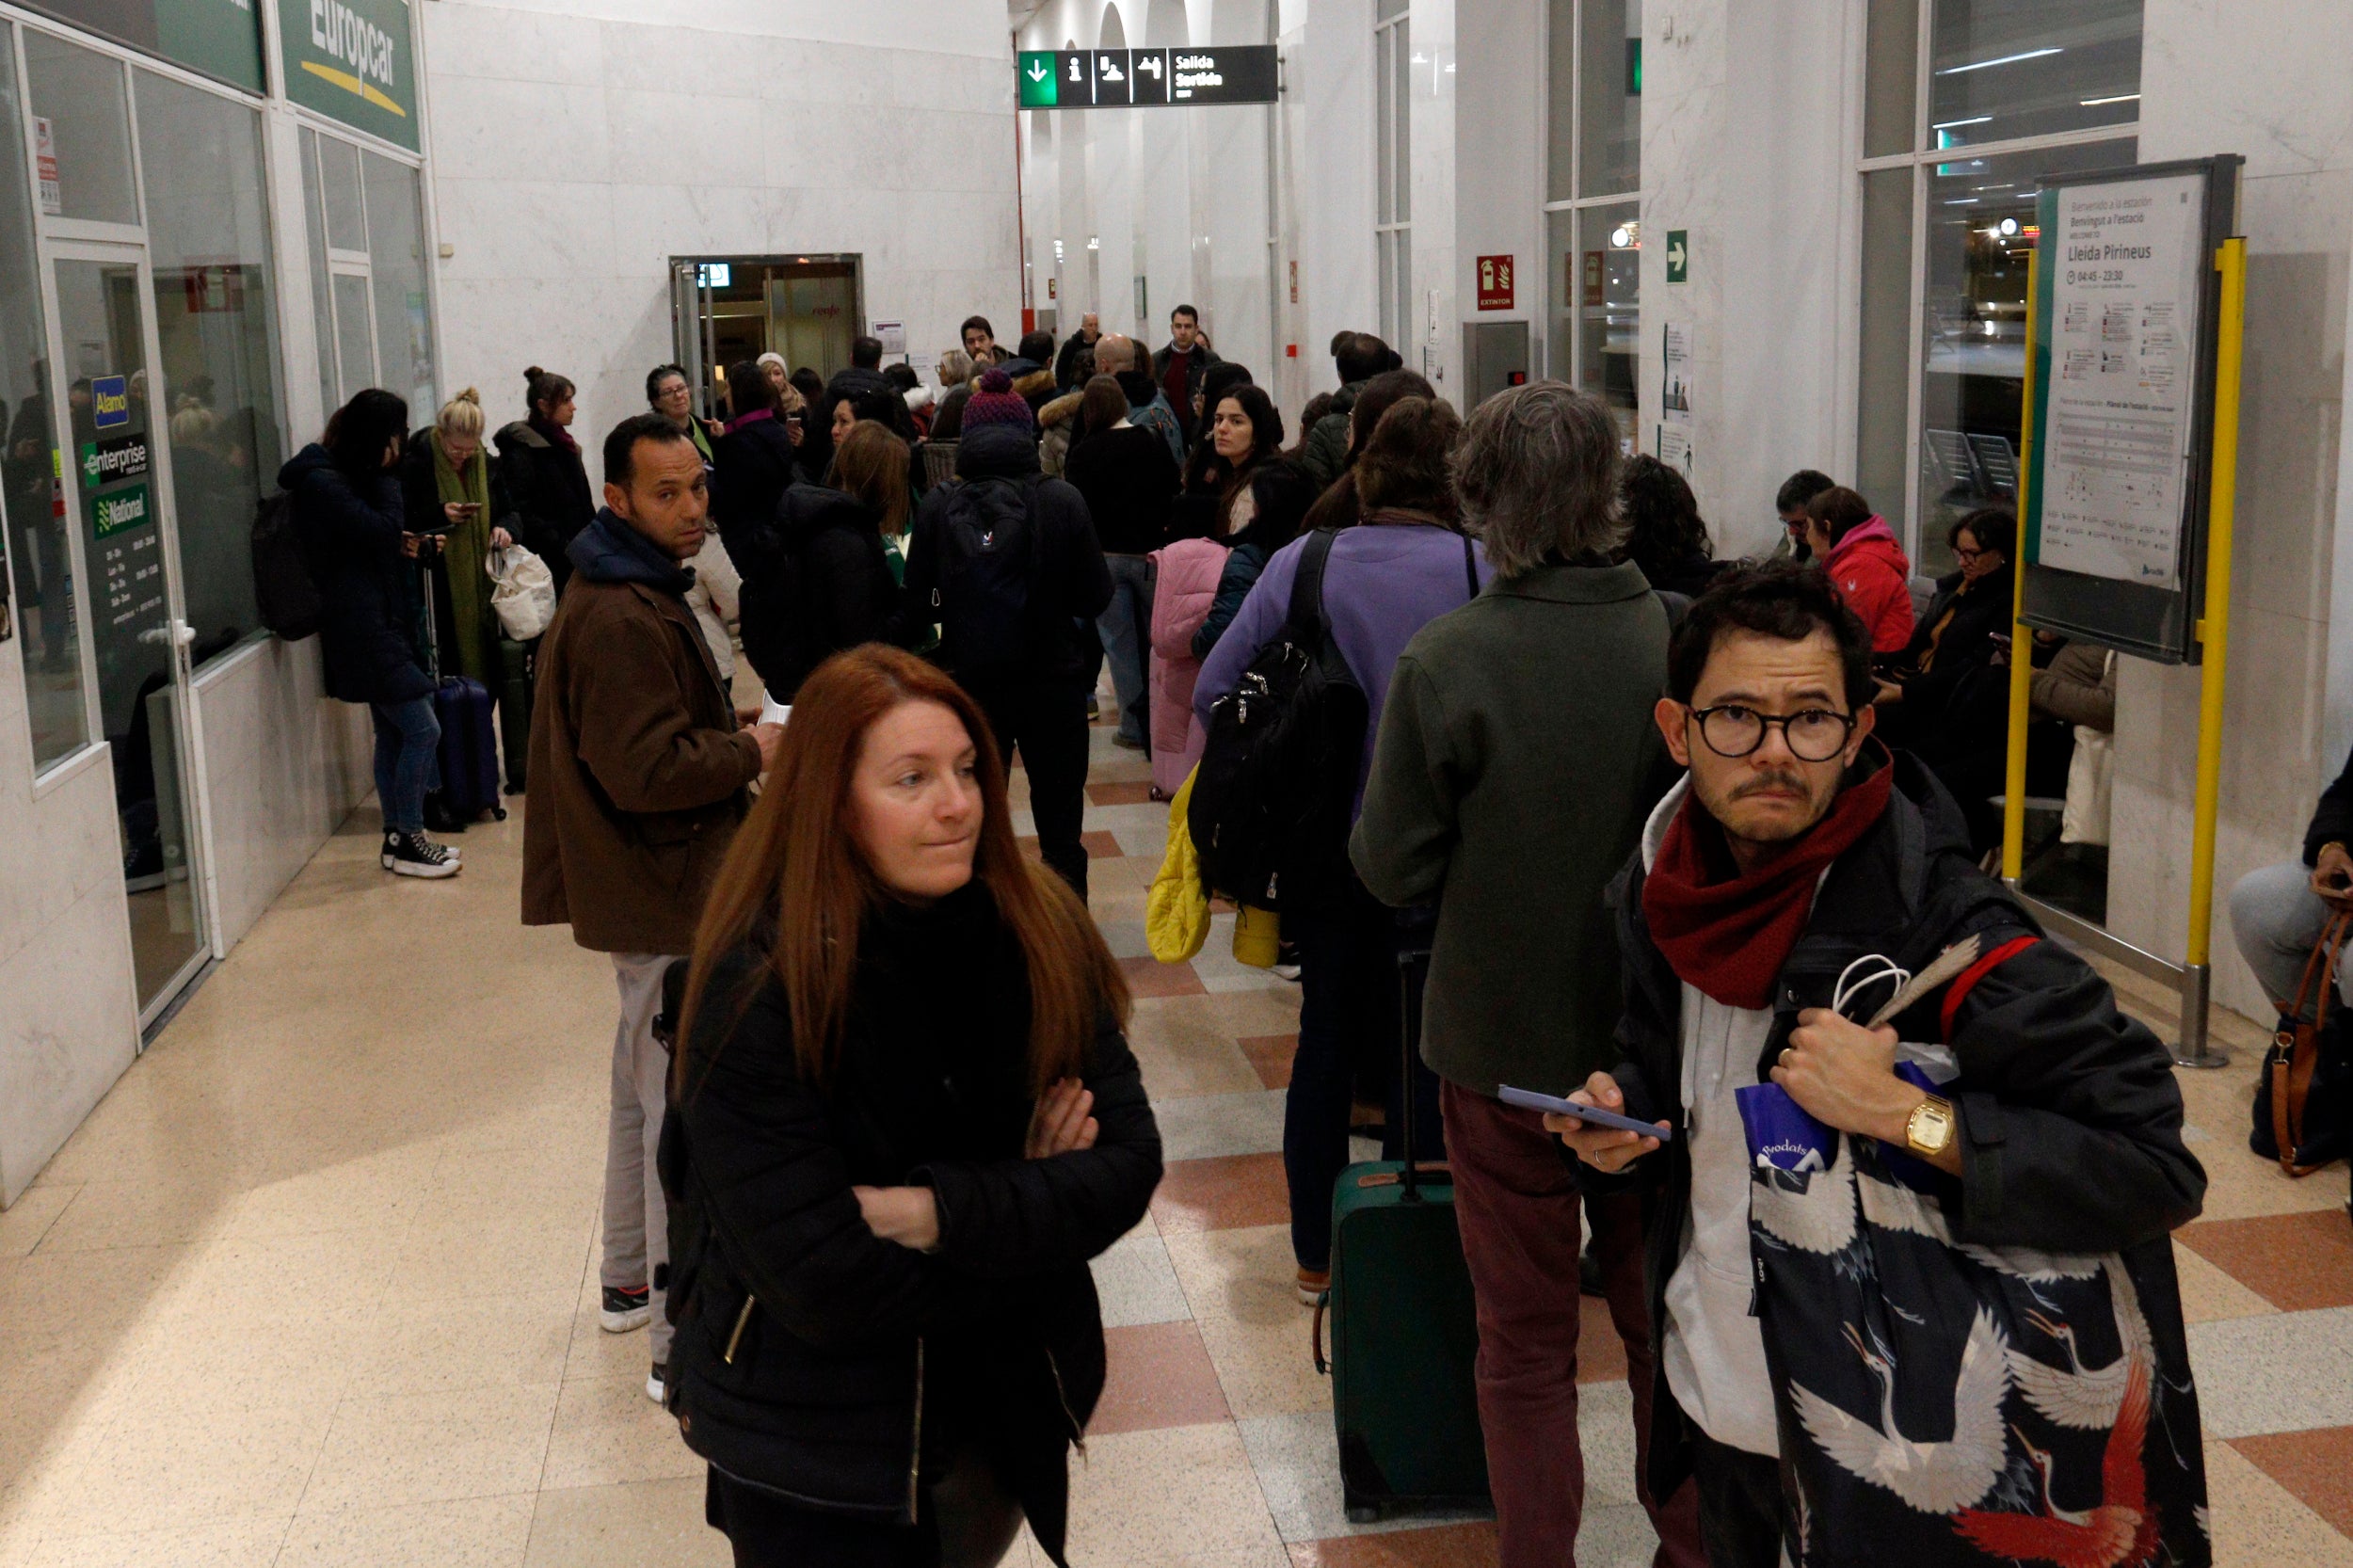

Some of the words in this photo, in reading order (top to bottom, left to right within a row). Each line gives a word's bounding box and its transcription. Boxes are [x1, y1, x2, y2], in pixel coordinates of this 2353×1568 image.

[311, 0, 393, 95] Europcar
[1176, 56, 1214, 69] Salida
[2071, 216, 2105, 228] Benvingut
[2114, 213, 2144, 225] l'estació
[2069, 245, 2101, 262] Lleida
[2104, 244, 2152, 261] Pirineus
[2077, 271, 2097, 281] 04:45
[2104, 270, 2123, 281] 23:30
[96, 392, 127, 414] Alamo
[84, 441, 147, 474] enterprise
[108, 492, 145, 526] National
